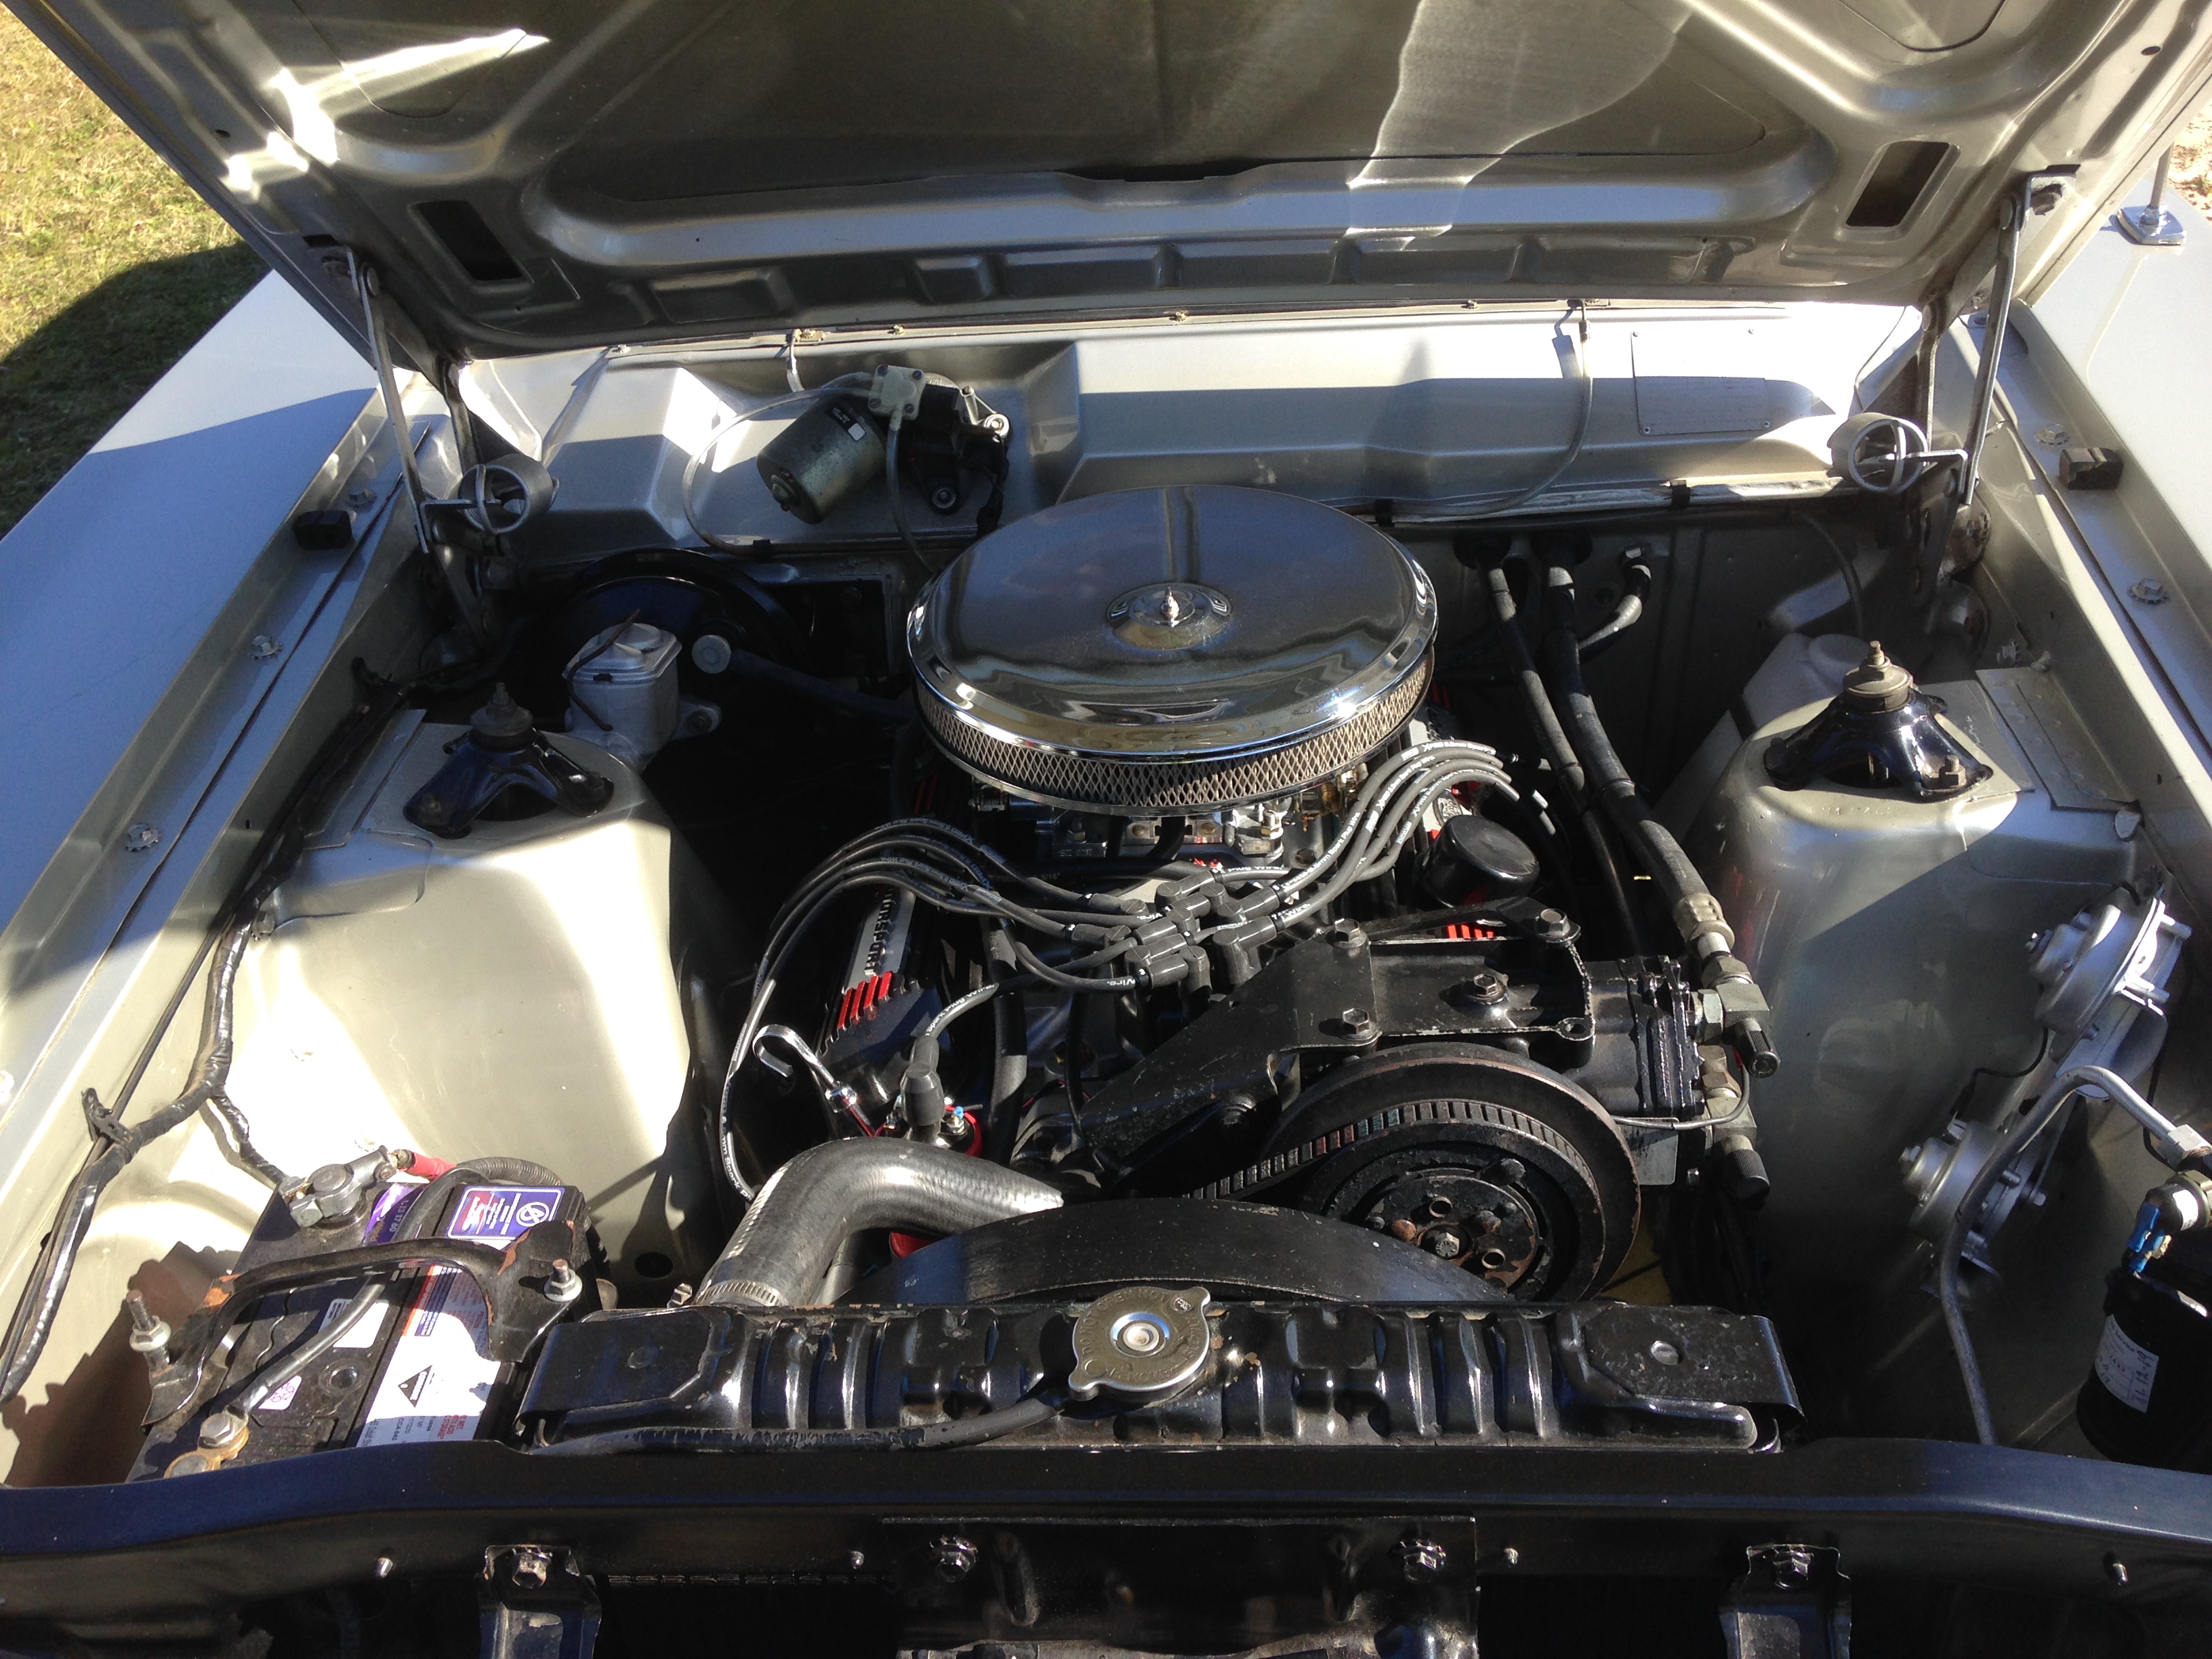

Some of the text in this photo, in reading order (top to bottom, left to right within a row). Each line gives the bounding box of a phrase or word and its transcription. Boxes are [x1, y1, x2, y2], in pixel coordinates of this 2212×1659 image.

[1327, 838, 1345, 855] Spark
[1340, 825, 1354, 840] Plug
[724, 1156, 741, 1190] Spark
